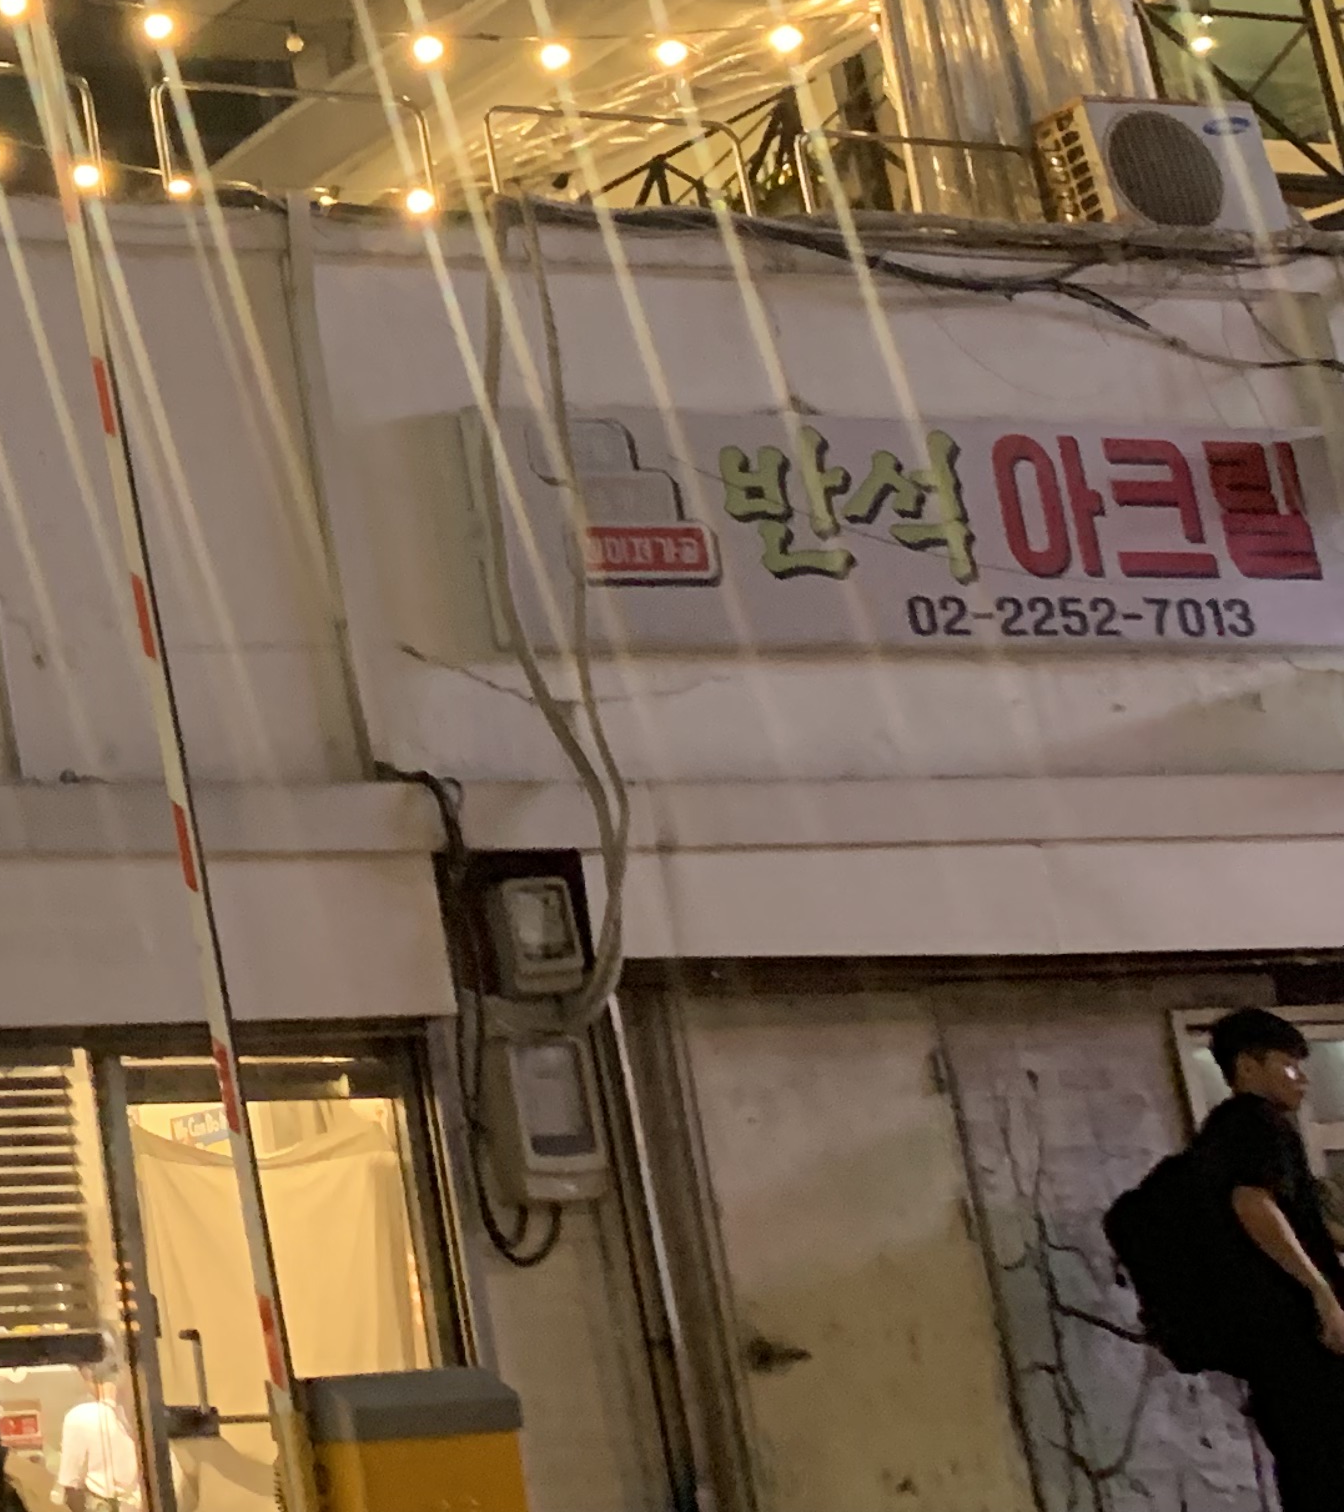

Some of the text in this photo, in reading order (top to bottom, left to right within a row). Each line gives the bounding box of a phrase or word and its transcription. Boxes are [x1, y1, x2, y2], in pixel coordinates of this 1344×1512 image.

[719, 425, 1324, 586] 반석 아크릴
[907, 595, 1257, 637] 02-2252-7013
